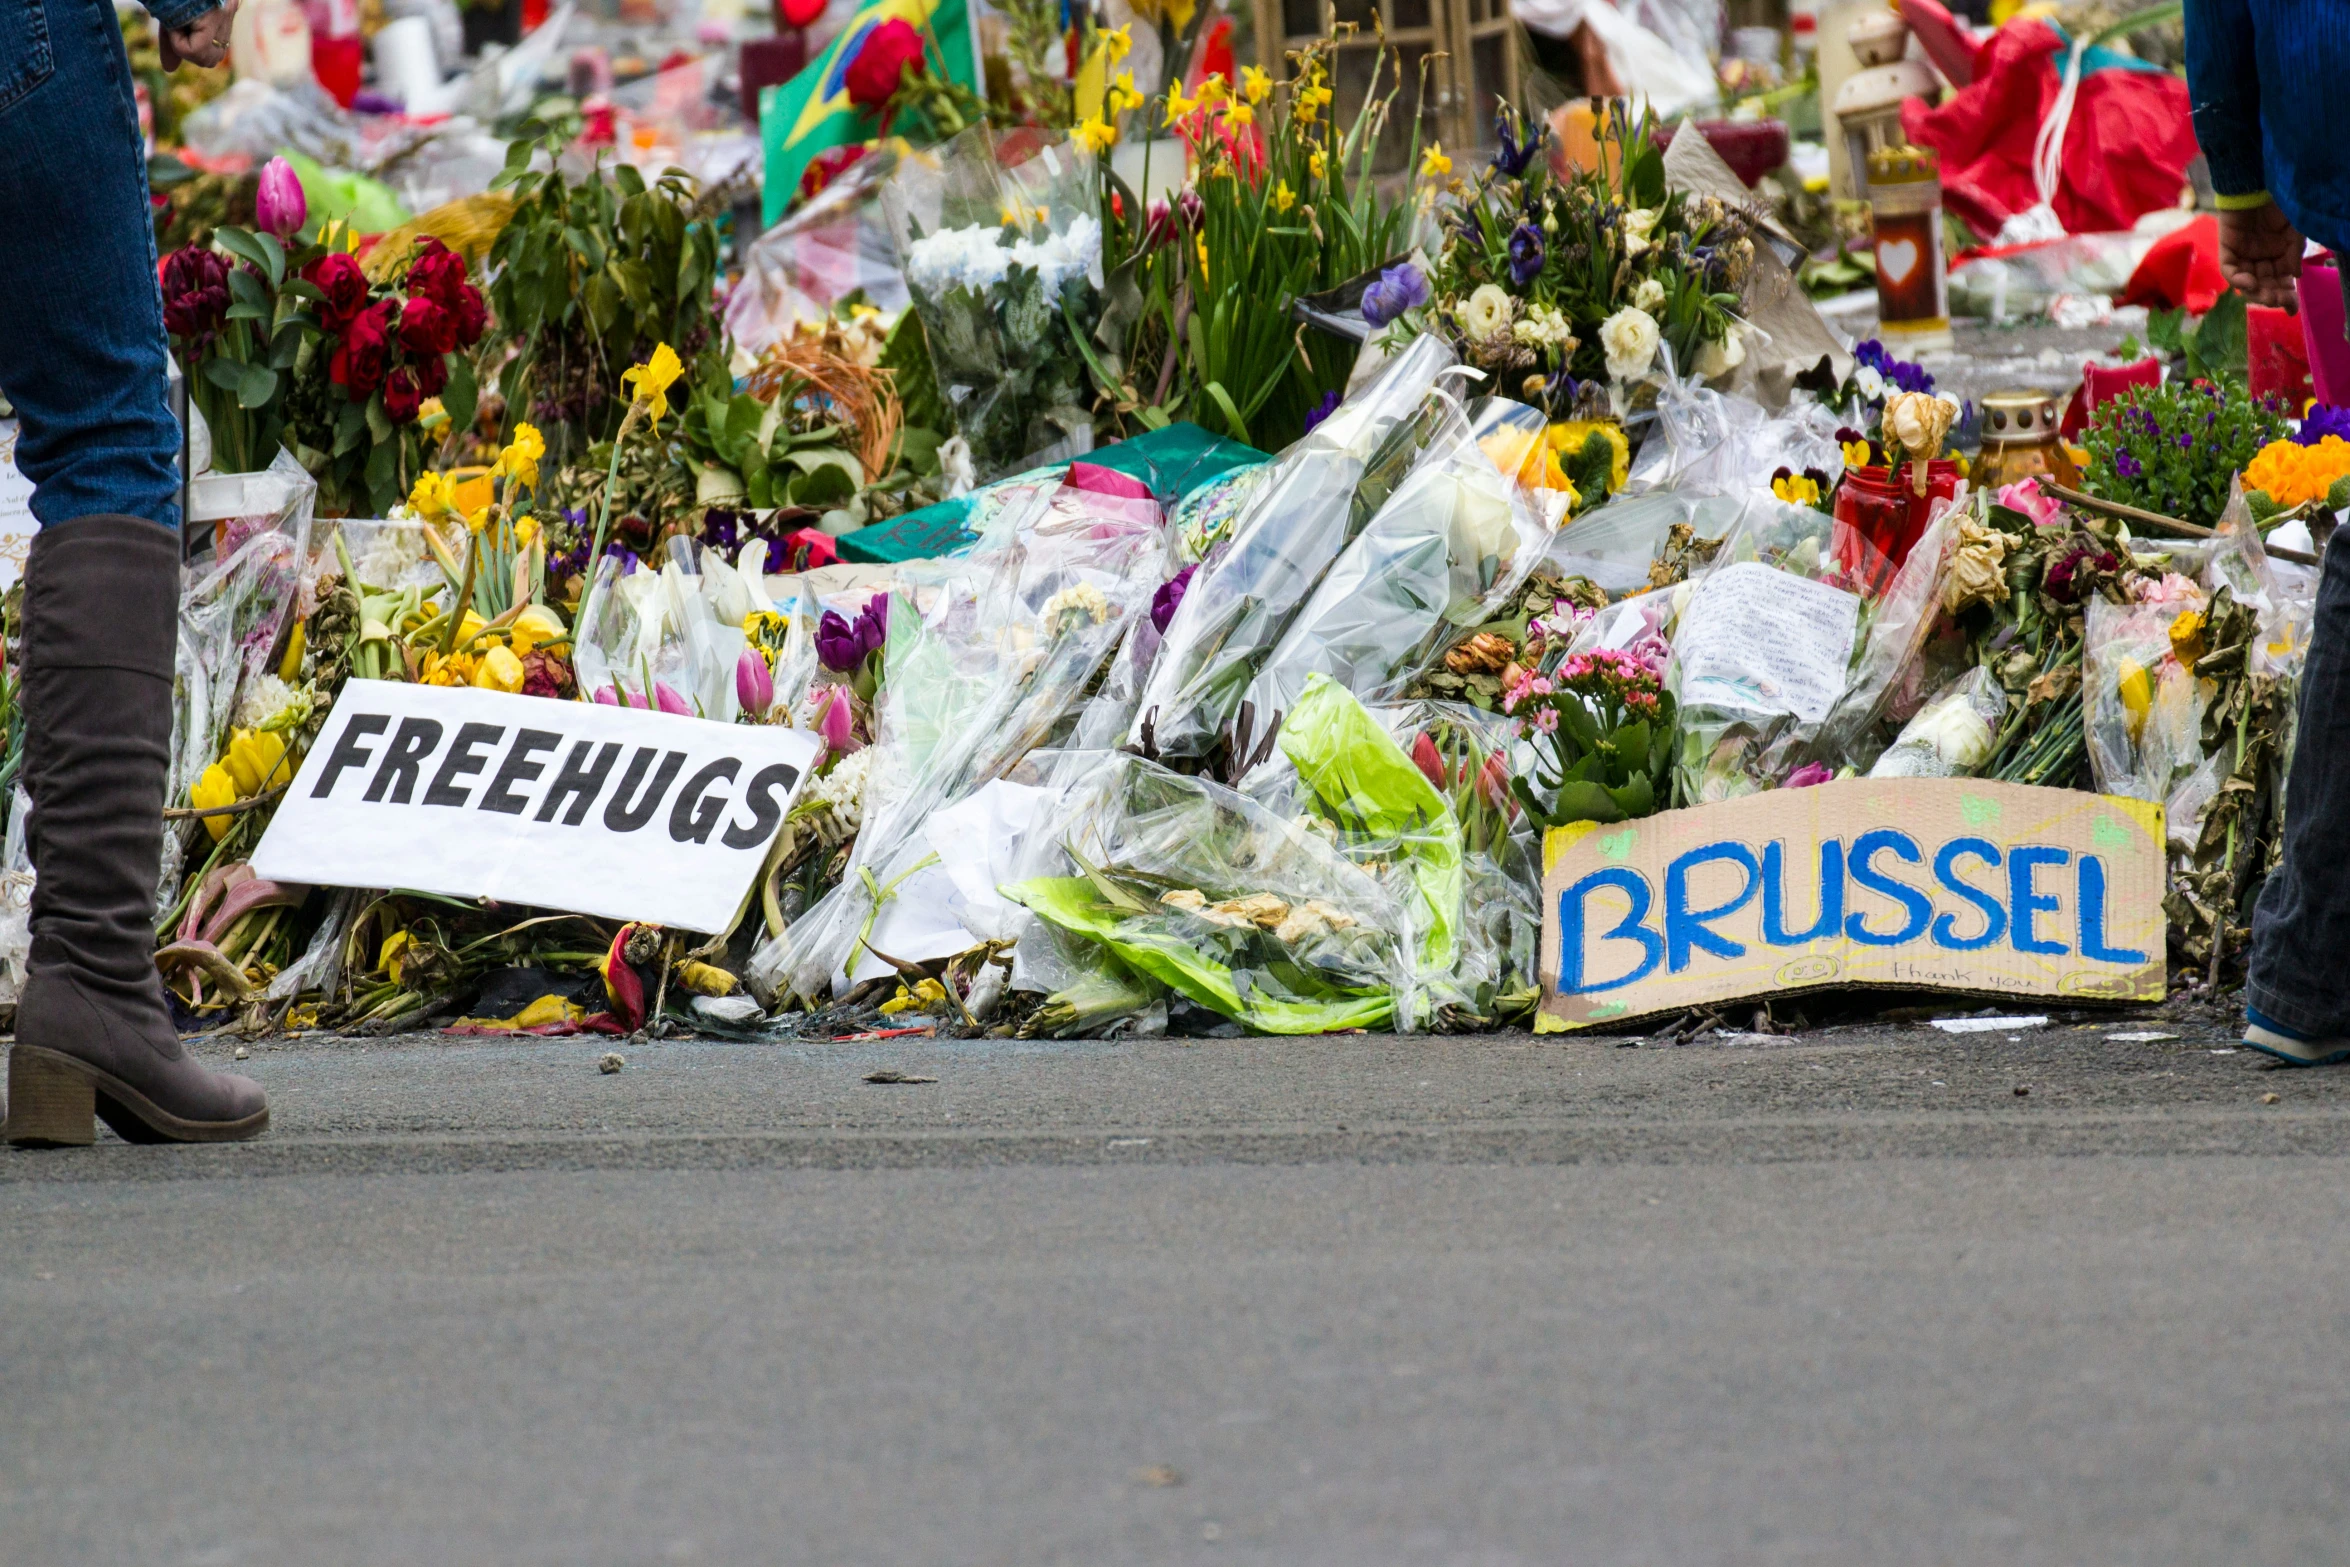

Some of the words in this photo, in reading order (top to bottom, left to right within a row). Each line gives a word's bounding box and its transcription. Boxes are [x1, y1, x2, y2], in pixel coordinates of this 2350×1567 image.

[310, 713, 801, 850] FREEHUGS
[1556, 827, 2150, 996] BRUSSEL
[1989, 975, 2039, 989] you
